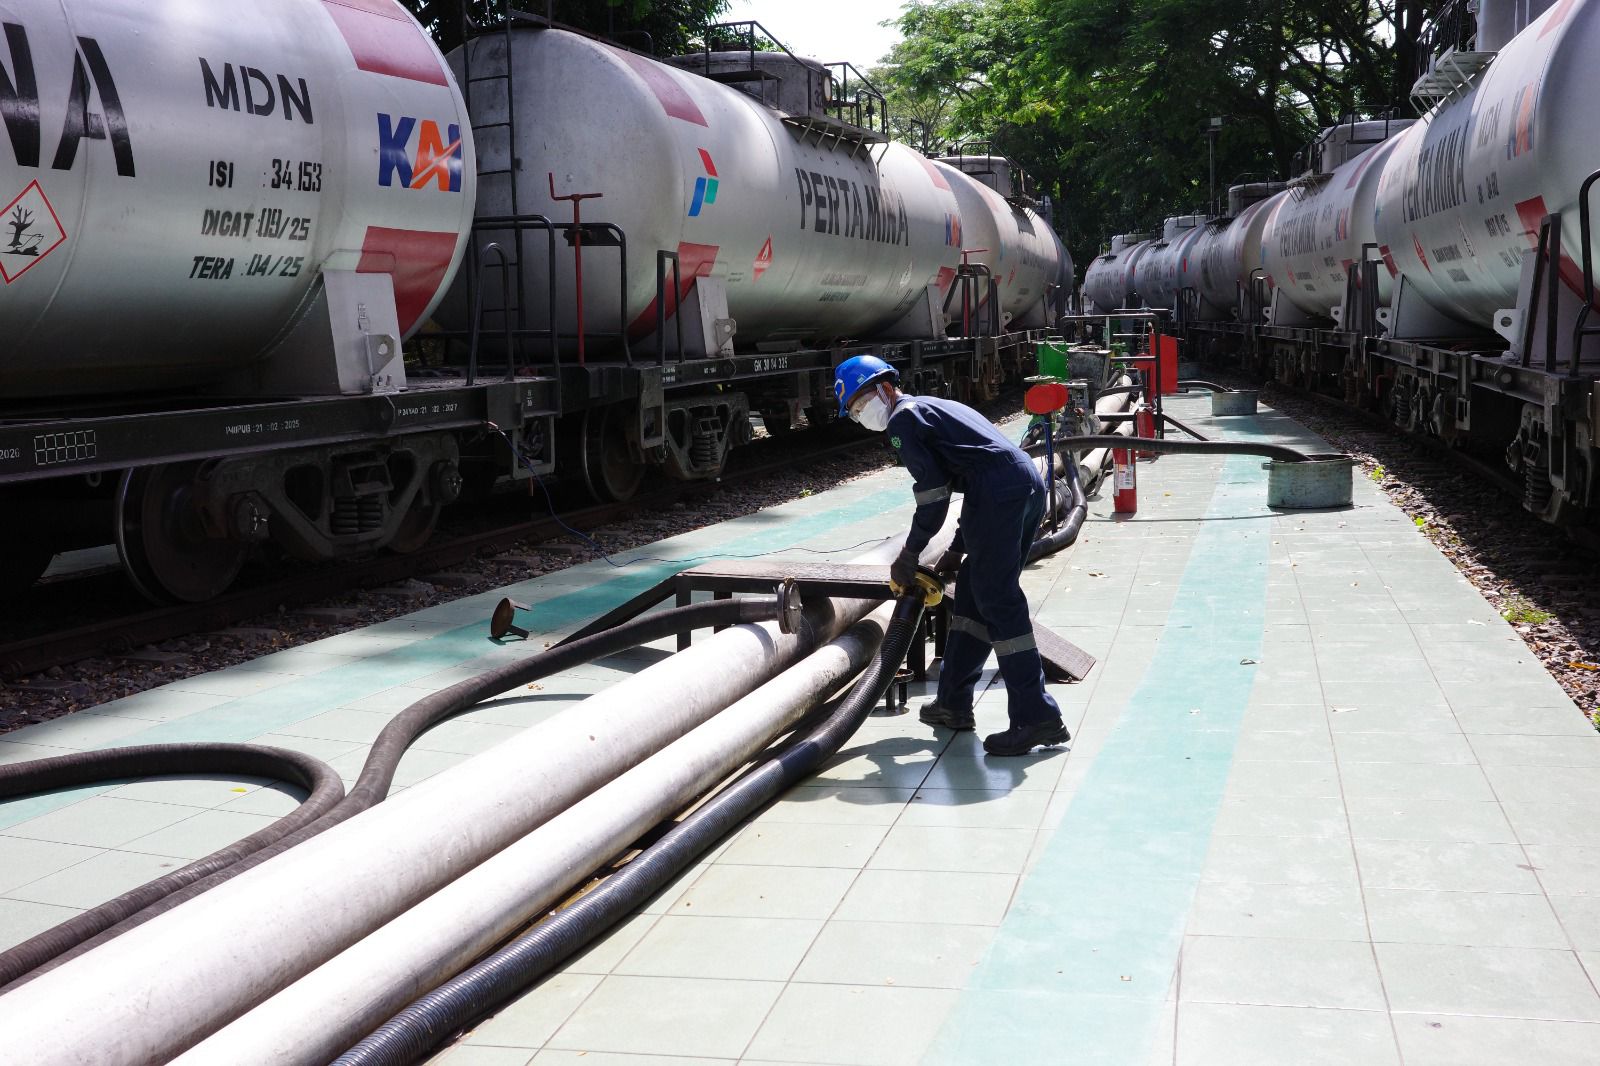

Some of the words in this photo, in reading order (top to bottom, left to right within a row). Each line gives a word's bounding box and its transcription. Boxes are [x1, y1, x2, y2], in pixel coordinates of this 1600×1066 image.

[199, 57, 313, 125] MDN
[208, 160, 234, 188] ISI
[376, 112, 462, 193] KAI
[200, 209, 255, 238] DICAT
[795, 167, 909, 247] PERTAMINA
[189, 255, 234, 280] TERA
